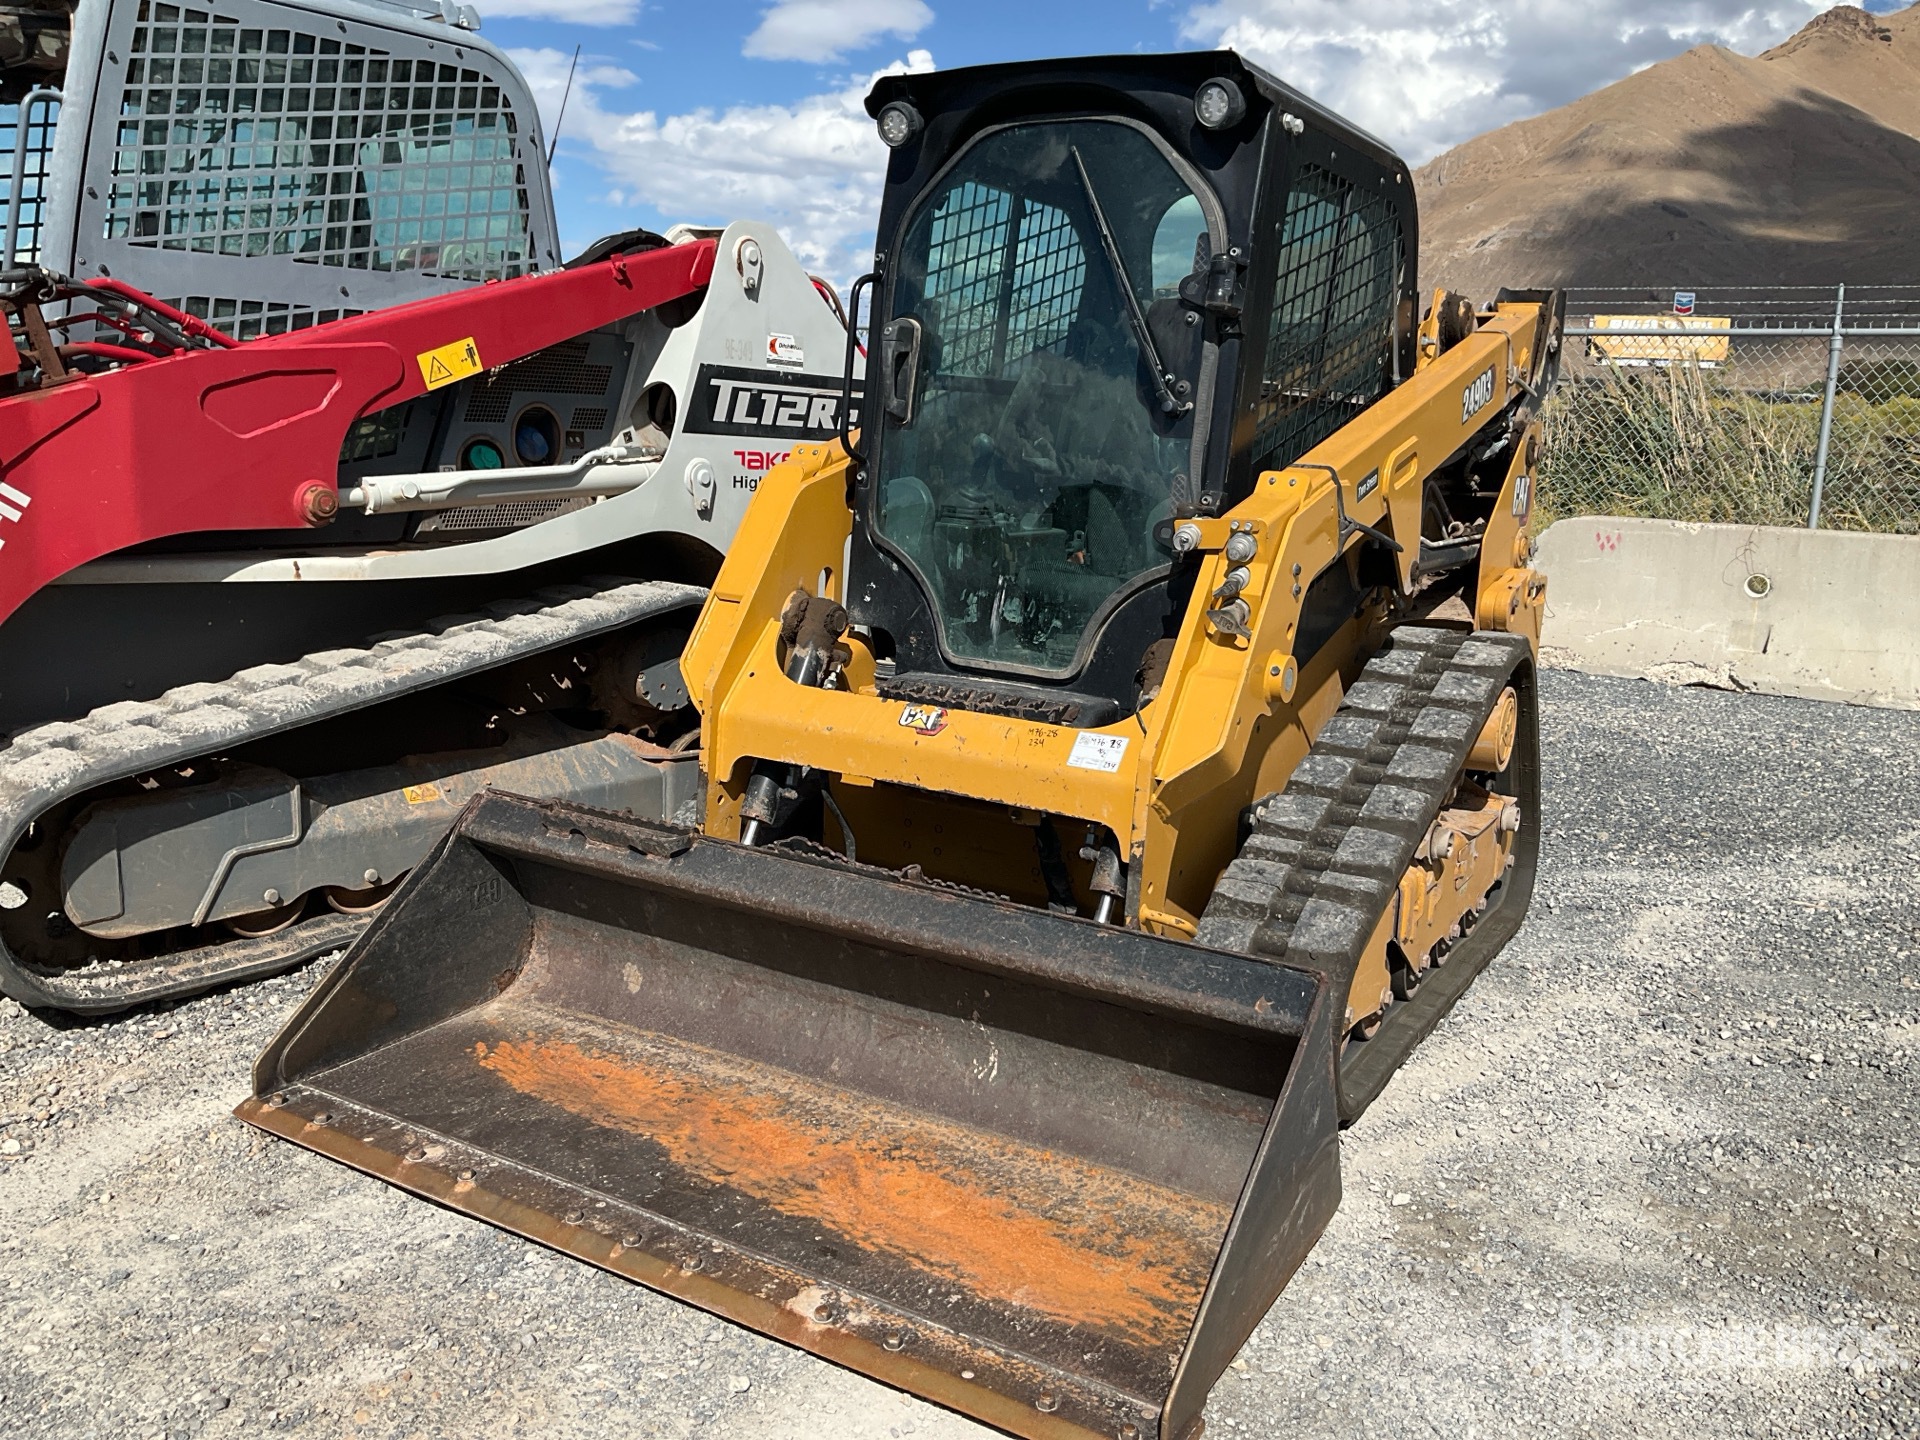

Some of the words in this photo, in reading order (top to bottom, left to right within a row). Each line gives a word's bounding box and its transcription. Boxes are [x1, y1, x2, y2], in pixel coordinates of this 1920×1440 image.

[1462, 368, 1493, 424] 249D3
[733, 475, 762, 492] Hig
[1512, 476, 1530, 516] CAT
[1028, 738, 1045, 748] 234
